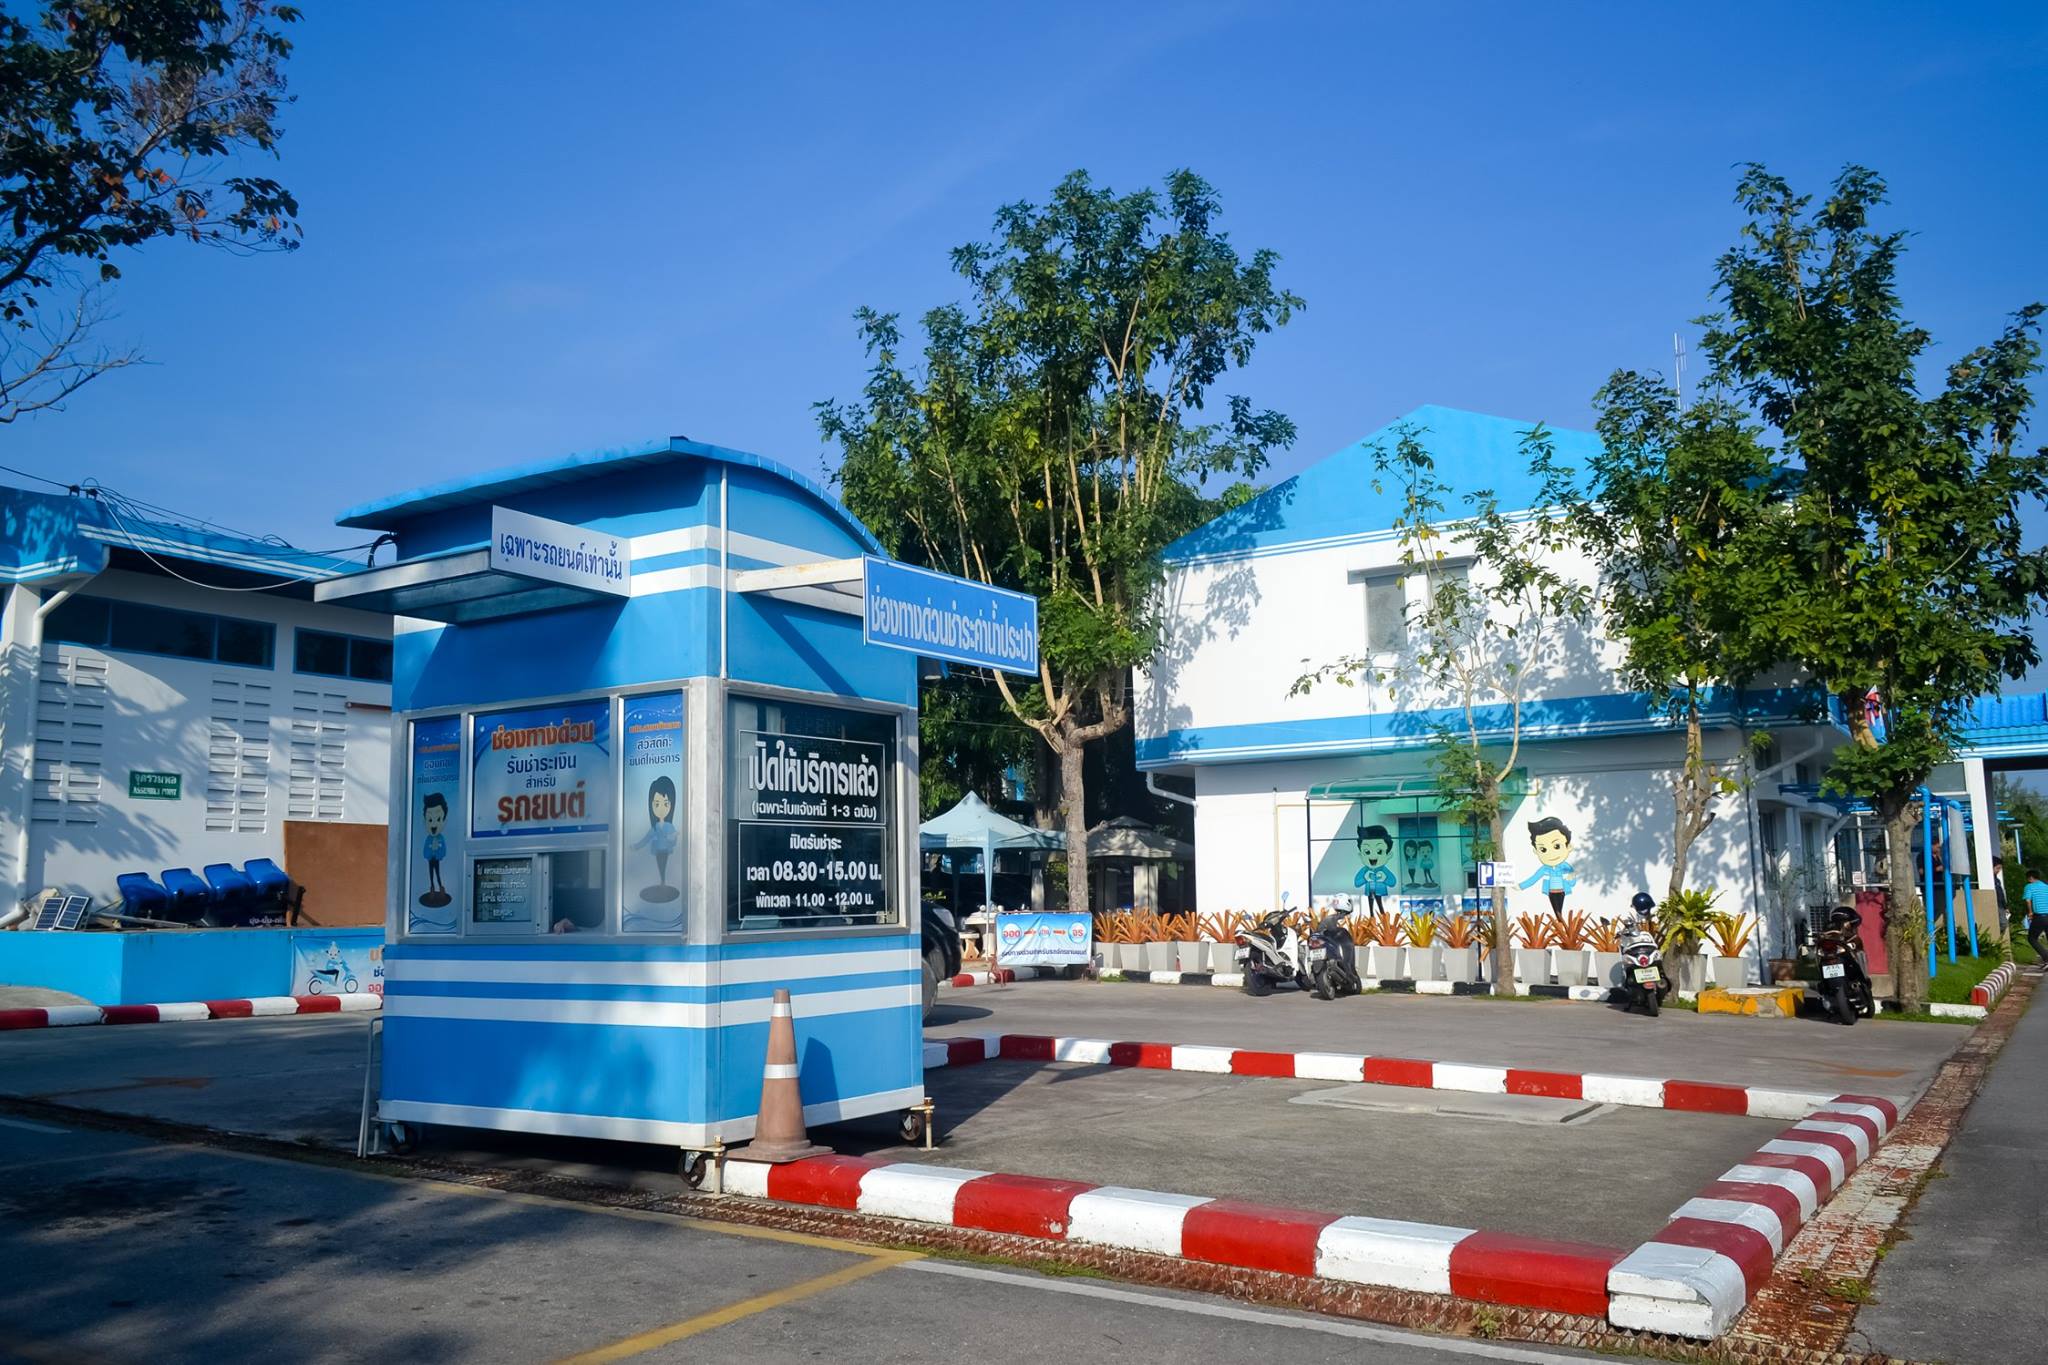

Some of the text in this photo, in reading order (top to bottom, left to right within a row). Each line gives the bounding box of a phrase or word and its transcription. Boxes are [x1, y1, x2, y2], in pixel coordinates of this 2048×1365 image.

[500, 533, 622, 580] เฉพาะรถยนต์เท่านั้น
[871, 585, 1033, 663] ช่องทางด่วนชำระค่าน้ำประปา
[492, 718, 595, 751] ช่องทางด่วน
[506, 752, 577, 775] รับชำระเงิน
[749, 740, 879, 797] เปิดให้บริการแล้ว
[525, 773, 557, 789] สำหรับ
[497, 781, 586, 824] รถยนต์
[752, 798, 877, 821] (เฉพาะใบแจ้งหนี้ 1-3 ฉบับ)
[789, 833, 842, 850] เปิดรับชำระ
[746, 866, 770, 881] เวลา
[869, 863, 882, 880] น.
[1481, 865, 1493, 884] P
[755, 891, 791, 909] พักเวลา
[795, 893, 825, 908] 11.00
[834, 891, 863, 907] 12.00
